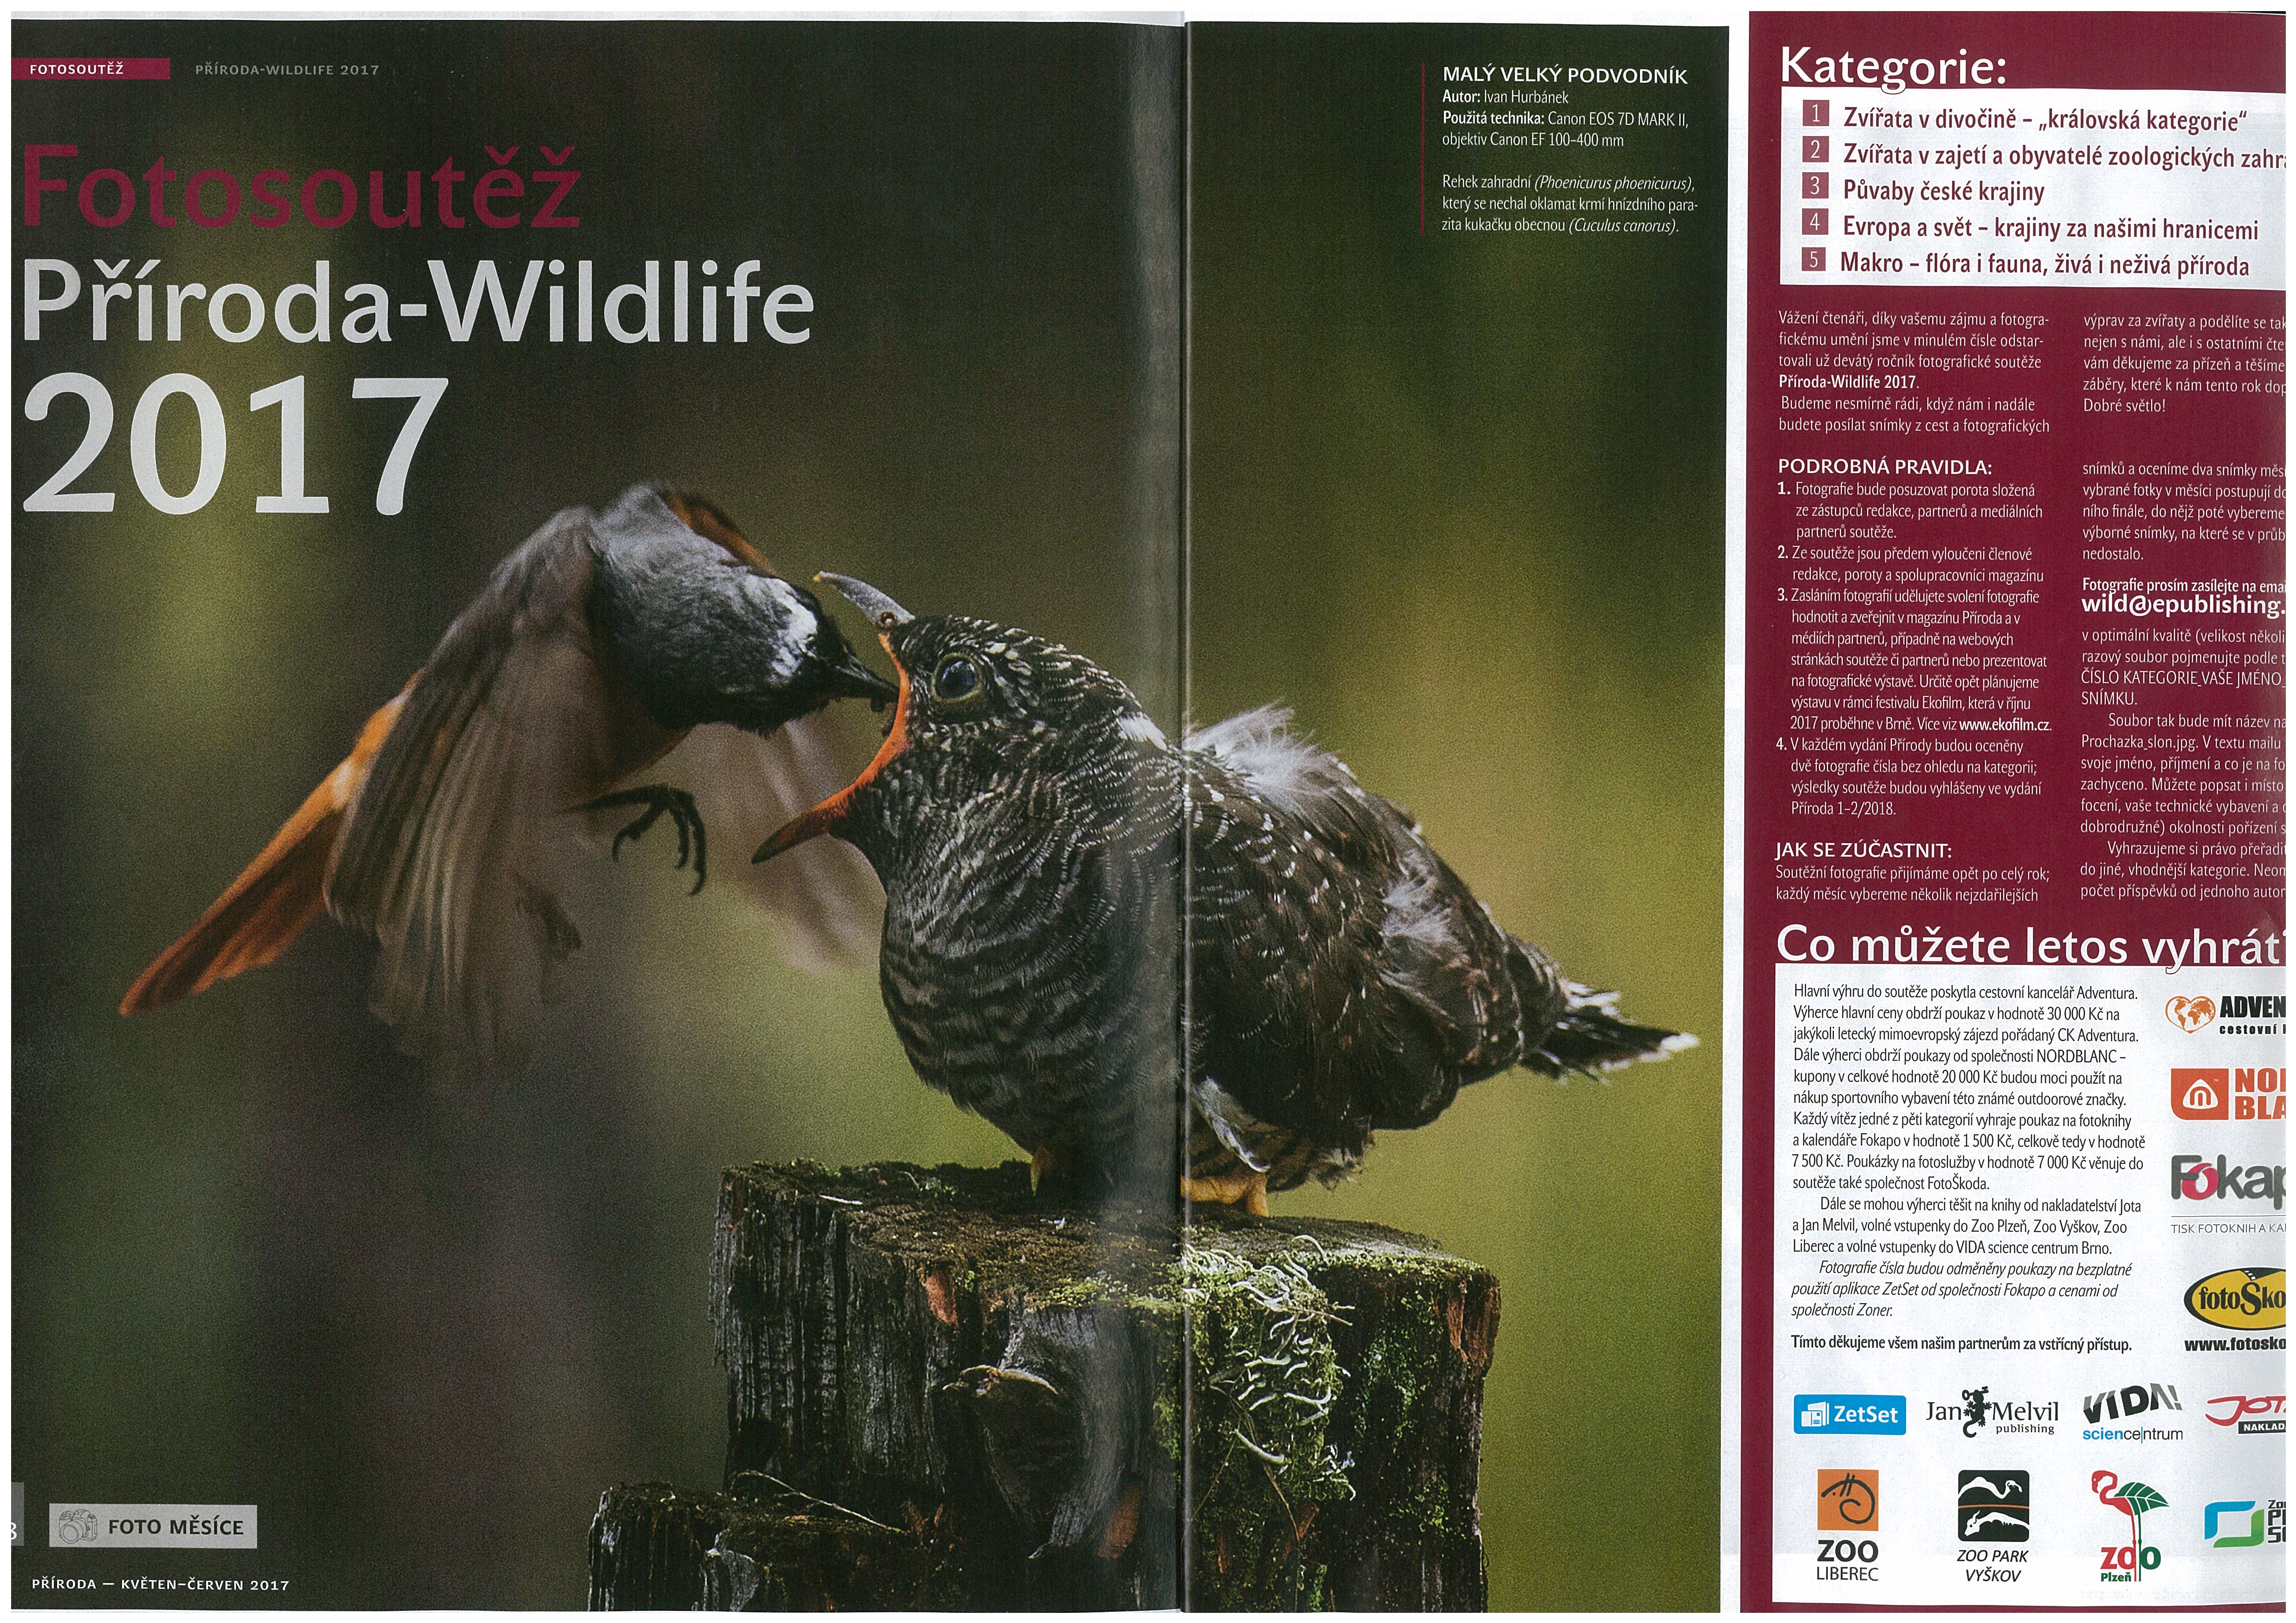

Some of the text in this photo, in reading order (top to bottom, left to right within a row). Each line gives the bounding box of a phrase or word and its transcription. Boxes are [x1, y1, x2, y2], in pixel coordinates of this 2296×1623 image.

[31, 62, 123, 74] FOTOSOUTĚŽ
[196, 61, 378, 74] PŘÍRODA-WILDLIFE 2017
[1444, 63, 1687, 84] MALÝ VELKÝ PODVODNÍK
[1782, 47, 2006, 94] Kategorie:
[1443, 89, 1568, 103] Autor: Ivan Hurbánek
[1444, 111, 1688, 128] Použitá technika: Canon EOS 7D MARK II,
[1813, 105, 1820, 122] 1
[1844, 107, 1912, 128] Zvířata
[1919, 115, 1929, 128] v
[1936, 108, 2016, 128] divočině
[2039, 108, 2140, 131] „královská
[2148, 110, 2247, 135] kategorie“
[1443, 132, 1623, 148] objektiv Canon EF 100–400 mm
[1811, 140, 2286, 172] 2 Zvířata v zajetí a obyvatelé zoologických zahr
[25, 145, 580, 234] Fotosoutěž
[1444, 174, 1694, 193] Rehek zahradní (Phoenicurus phoenicurus),
[1811, 176, 2044, 206] 3 Půvaby české krajiny
[1443, 196, 1697, 214] který se nechal oklamat krmí hnízdního para-
[1442, 217, 1678, 235] zita kukačku obecnou (Cuculus canorus).
[1810, 213, 1820, 230] 4
[1845, 215, 1910, 241] Evropa
[1918, 222, 1927, 236] a
[1934, 217, 1971, 236] svět
[1996, 217, 2061, 242] krajiny
[2067, 223, 2086, 237] za
[2094, 218, 2155, 237] našimi
[2164, 218, 2258, 240] hranicemi
[1810, 252, 1817, 267] 5
[1841, 252, 1902, 272] Makro
[1926, 253, 1970, 272] flóra
[1978, 253, 1981, 272] i
[1988, 253, 2047, 276] fauna,
[2055, 253, 2091, 273] živá
[2099, 254, 2103, 273] i
[2111, 254, 2170, 274] neživá
[2179, 255, 2249, 279] příroda
[25, 259, 814, 344] Příroda-Wildlife
[1779, 311, 2049, 329] Vážení čtenáři, díky vašemu zájmu a fotogra-
[1780, 375, 1919, 388] Příroda-Wildlife 2017.
[2085, 398, 2165, 412] Dobré světlo!
[24, 373, 448, 515] 2017
[1779, 456, 1991, 474] PODROBNÁ PRAVIDLA:
[2083, 578, 2144, 594] Fotografie
[2148, 578, 2187, 594] prosím
[2191, 579, 2238, 595] zasílejte
[2243, 583, 2256, 592] na
[2082, 594, 2285, 618] wild@epublishing.
[1791, 716, 2051, 732] 2017 proběhne v Brně. Více viz www.ekofilm.cz.
[1775, 839, 1951, 861] JAK SE ZÚČASTNIT:
[1778, 924, 1834, 961] Co
[1853, 925, 2009, 962] můžete
[2027, 927, 2127, 963] letos
[2220, 996, 2285, 1017] ADVEN
[2220, 1024, 2277, 1034] cestovní
[2171, 1224, 2194, 1233] TISK
[2198, 1224, 2255, 1233] FOTOKNIH
[2259, 1224, 2266, 1232] A
[1791, 1335, 2131, 1354] Tímto děkujeme všem našim partnerům za vstřícný přístup.
[2185, 1336, 2285, 1351] www.fotosko
[1834, 1406, 1898, 1423] ZetSet
[1926, 1402, 2058, 1420] Jan Melvil
[1996, 1424, 2054, 1435] publishing
[110, 1515, 243, 1535] FOTO MĚSÍCE
[1817, 1540, 1878, 1562] ZOO
[1957, 1550, 2029, 1562] ZOO PARK
[2100, 1547, 2161, 1569] ZOO
[33, 1576, 96, 1589] PŘÍRODA
[122, 1576, 242, 1590] KVĚTEN–ČERVEN
[251, 1581, 289, 1590] 2017
[1817, 1567, 1878, 1581] LIBEREC
[1966, 1567, 2021, 1582] VYŠKOV
[2101, 1572, 2131, 1581] Plzeň
